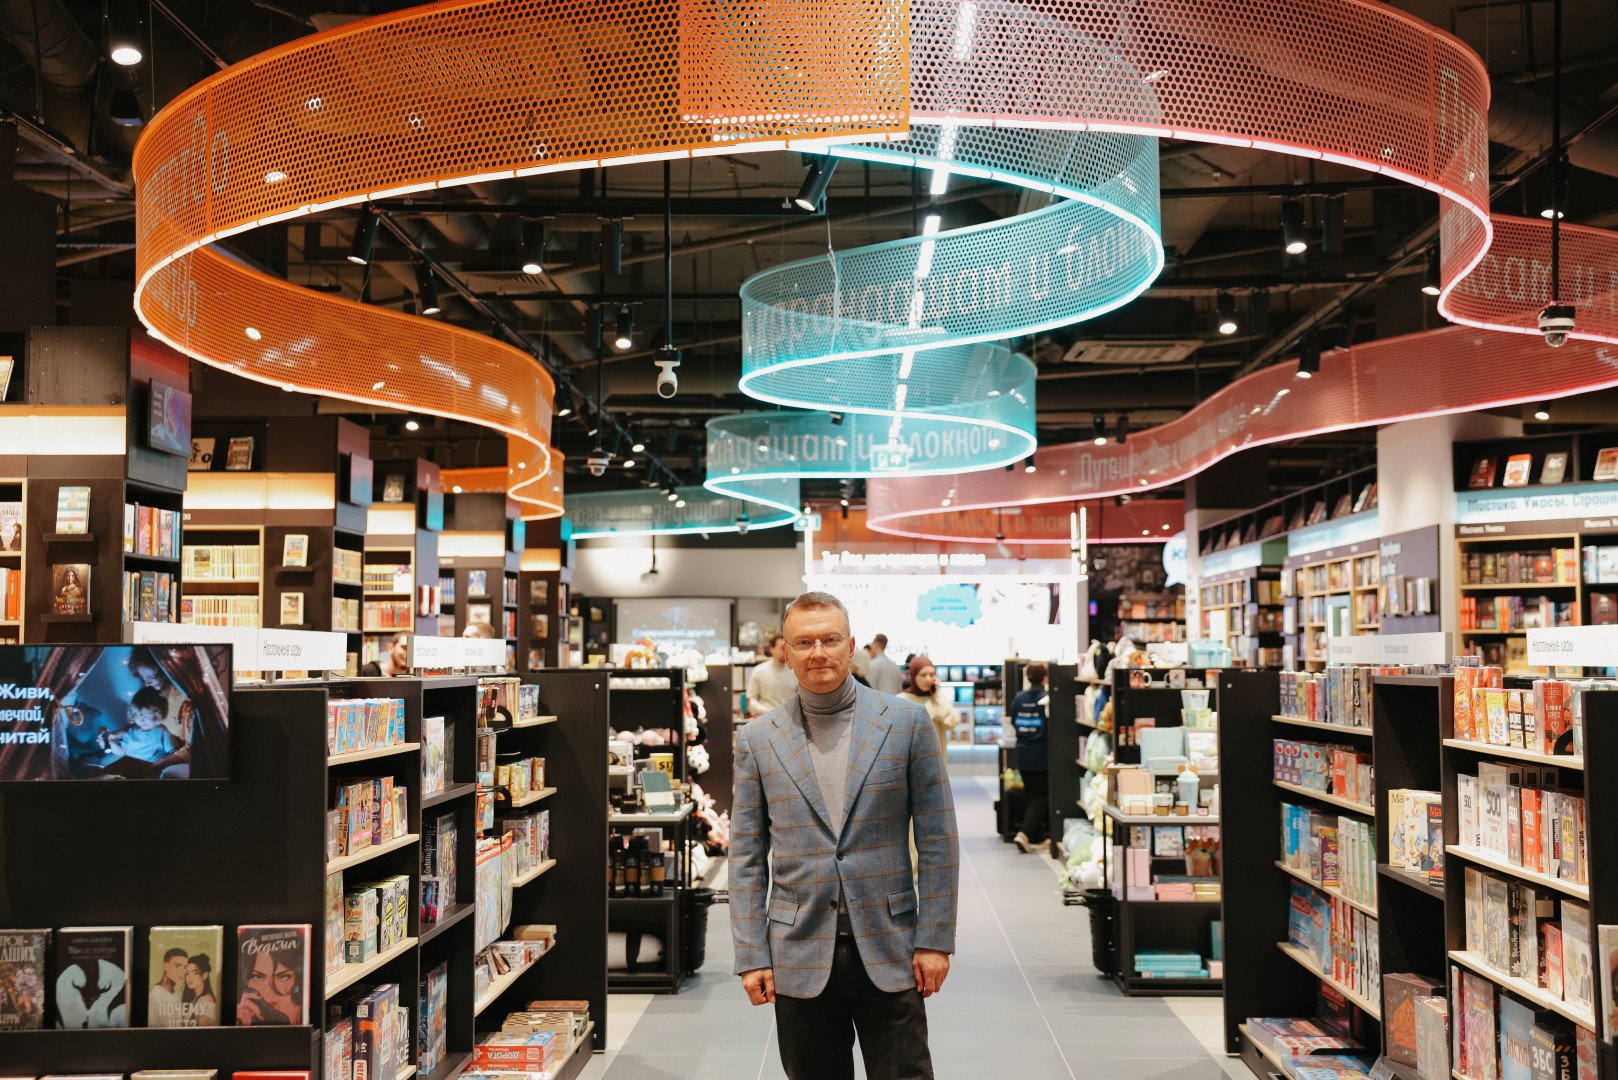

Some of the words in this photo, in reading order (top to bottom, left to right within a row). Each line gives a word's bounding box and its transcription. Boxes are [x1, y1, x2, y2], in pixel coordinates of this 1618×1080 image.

[0, 683, 55, 702] Живи,
[1487, 790, 1501, 817] 500
[241, 938, 300, 957] Ведьма
[158, 1001, 207, 1017] ПОЧЕМУ
